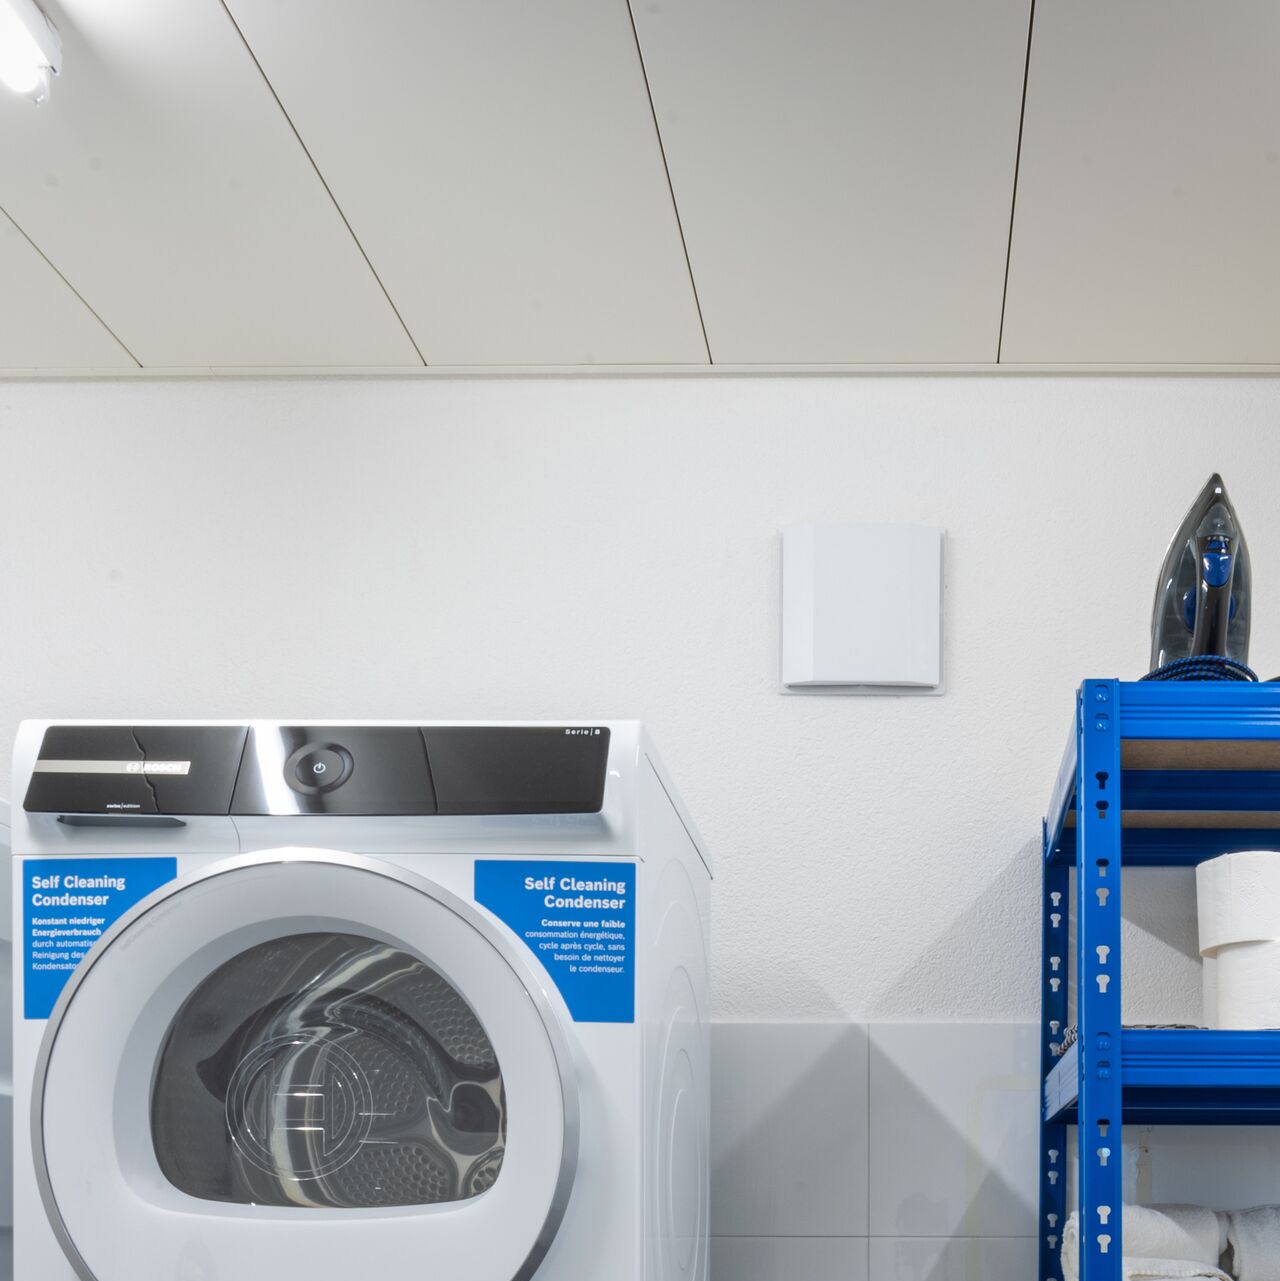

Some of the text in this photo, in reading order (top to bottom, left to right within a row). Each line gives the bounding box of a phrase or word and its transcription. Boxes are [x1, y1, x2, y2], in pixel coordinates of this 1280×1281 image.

[31, 875, 126, 891] Self Cleaning
[524, 876, 626, 894] Self Cleaning
[31, 892, 109, 906] Condenser
[544, 895, 626, 909] Condenser
[31, 916, 106, 926] Konstant niedriger
[541, 919, 581, 927] Conserve
[601, 919, 626, 928] faible
[31, 928, 102, 938] Energieverbrauch
[525, 930, 578, 938] consommation
[31, 940, 54, 948] durch
[539, 941, 559, 950] cycle
[560, 942, 582, 951] après
[31, 951, 70, 960] Reinigung
[554, 953, 626, 963] besoin de nettoyer
